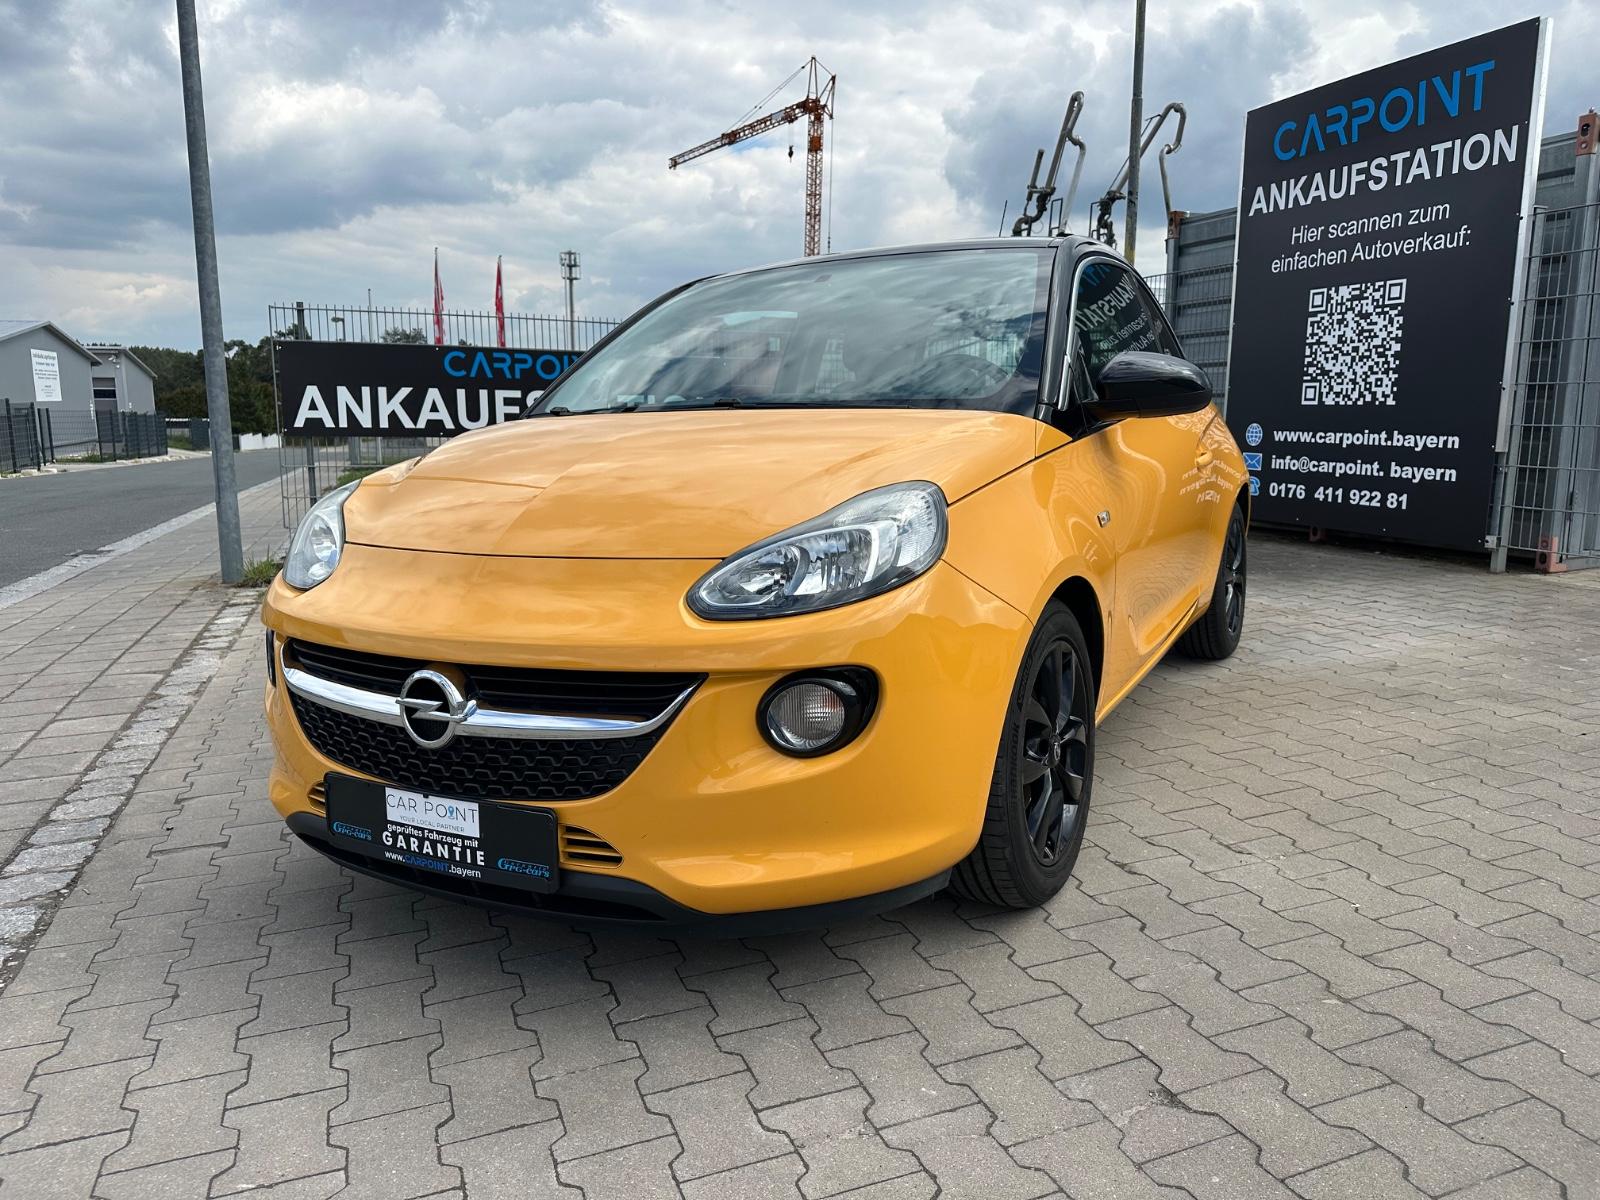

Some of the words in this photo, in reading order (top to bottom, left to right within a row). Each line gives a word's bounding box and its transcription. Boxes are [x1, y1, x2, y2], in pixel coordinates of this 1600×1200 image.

[1273, 60, 1495, 161] CARPOINT
[1249, 125, 1519, 216] ANKAUFSTATION
[1291, 223, 1325, 245] Hier
[1328, 210, 1402, 238] scannen
[1408, 203, 1450, 226] zum
[1271, 248, 1347, 273] einfachen
[1351, 225, 1471, 263] Autoverkauf:
[1273, 429, 1460, 451] www.carpoint.bayern
[1271, 455, 1384, 477] info@carpoint.
[1390, 461, 1457, 483] bayern
[1269, 482, 1306, 499] 0176
[1314, 486, 1343, 503] 411
[1349, 489, 1381, 507] 922
[1386, 493, 1408, 510] 81
[386, 794, 417, 813] CAR
[387, 823, 423, 836] geprüftes
[424, 831, 462, 846] Fahrzeug
[465, 838, 479, 848] mit
[417, 819, 435, 828] LOCAL
[437, 823, 465, 832] PARTNER
[382, 831, 485, 866] GARANTIE
[384, 851, 481, 878] www.CARPOINT.bayern
